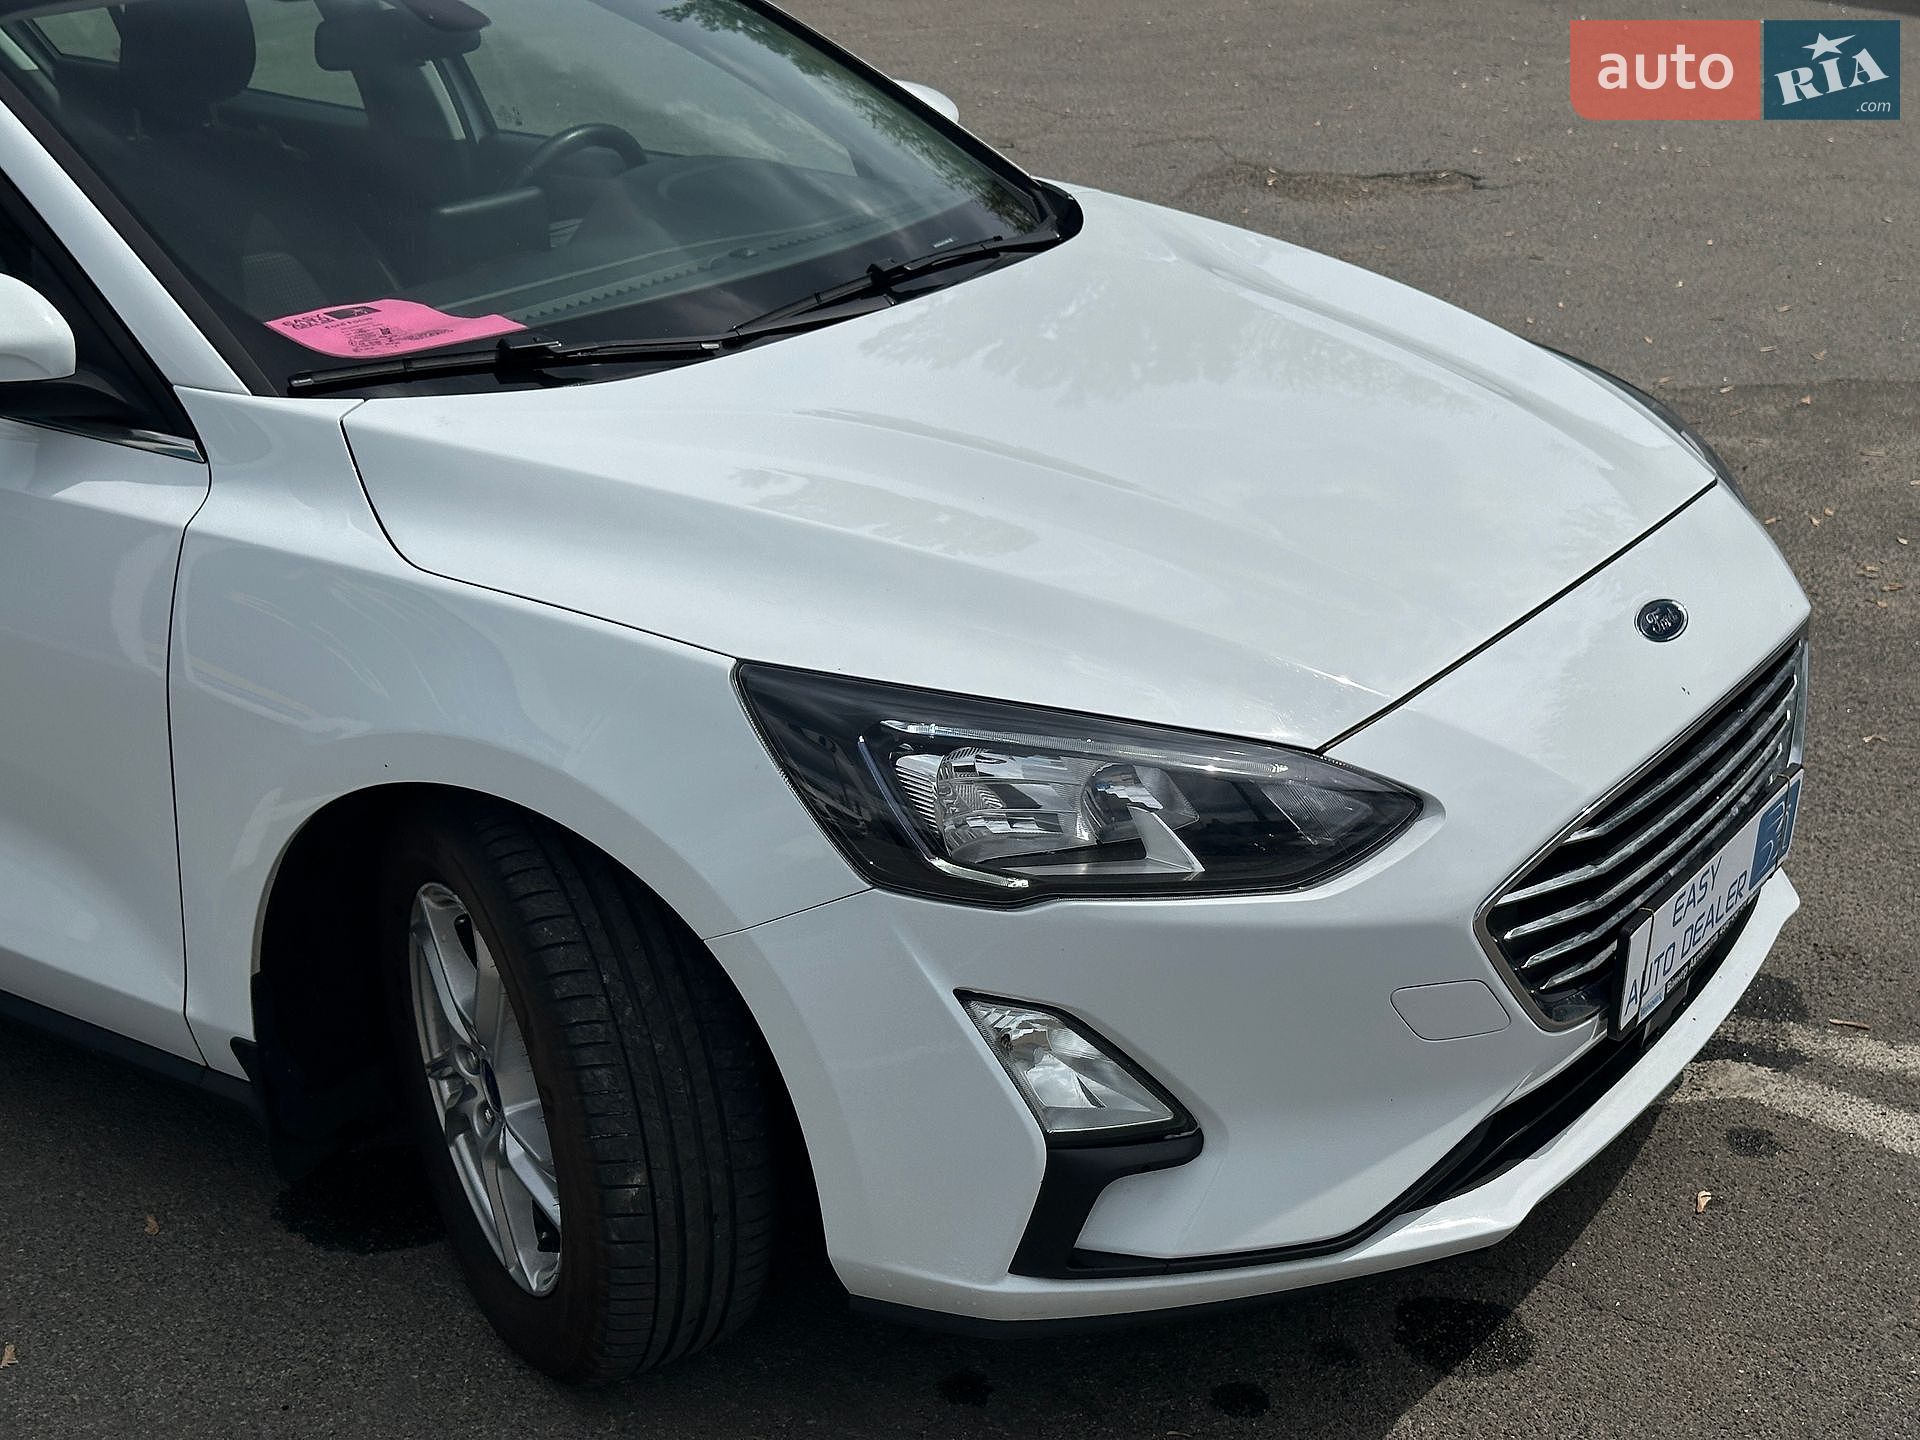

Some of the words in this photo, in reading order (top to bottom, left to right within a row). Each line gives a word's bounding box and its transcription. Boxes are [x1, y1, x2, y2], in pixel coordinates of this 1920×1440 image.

[1624, 941, 1676, 1016] AUTO
[1680, 869, 1748, 960] DEALER
[1672, 855, 1723, 928] EASY
